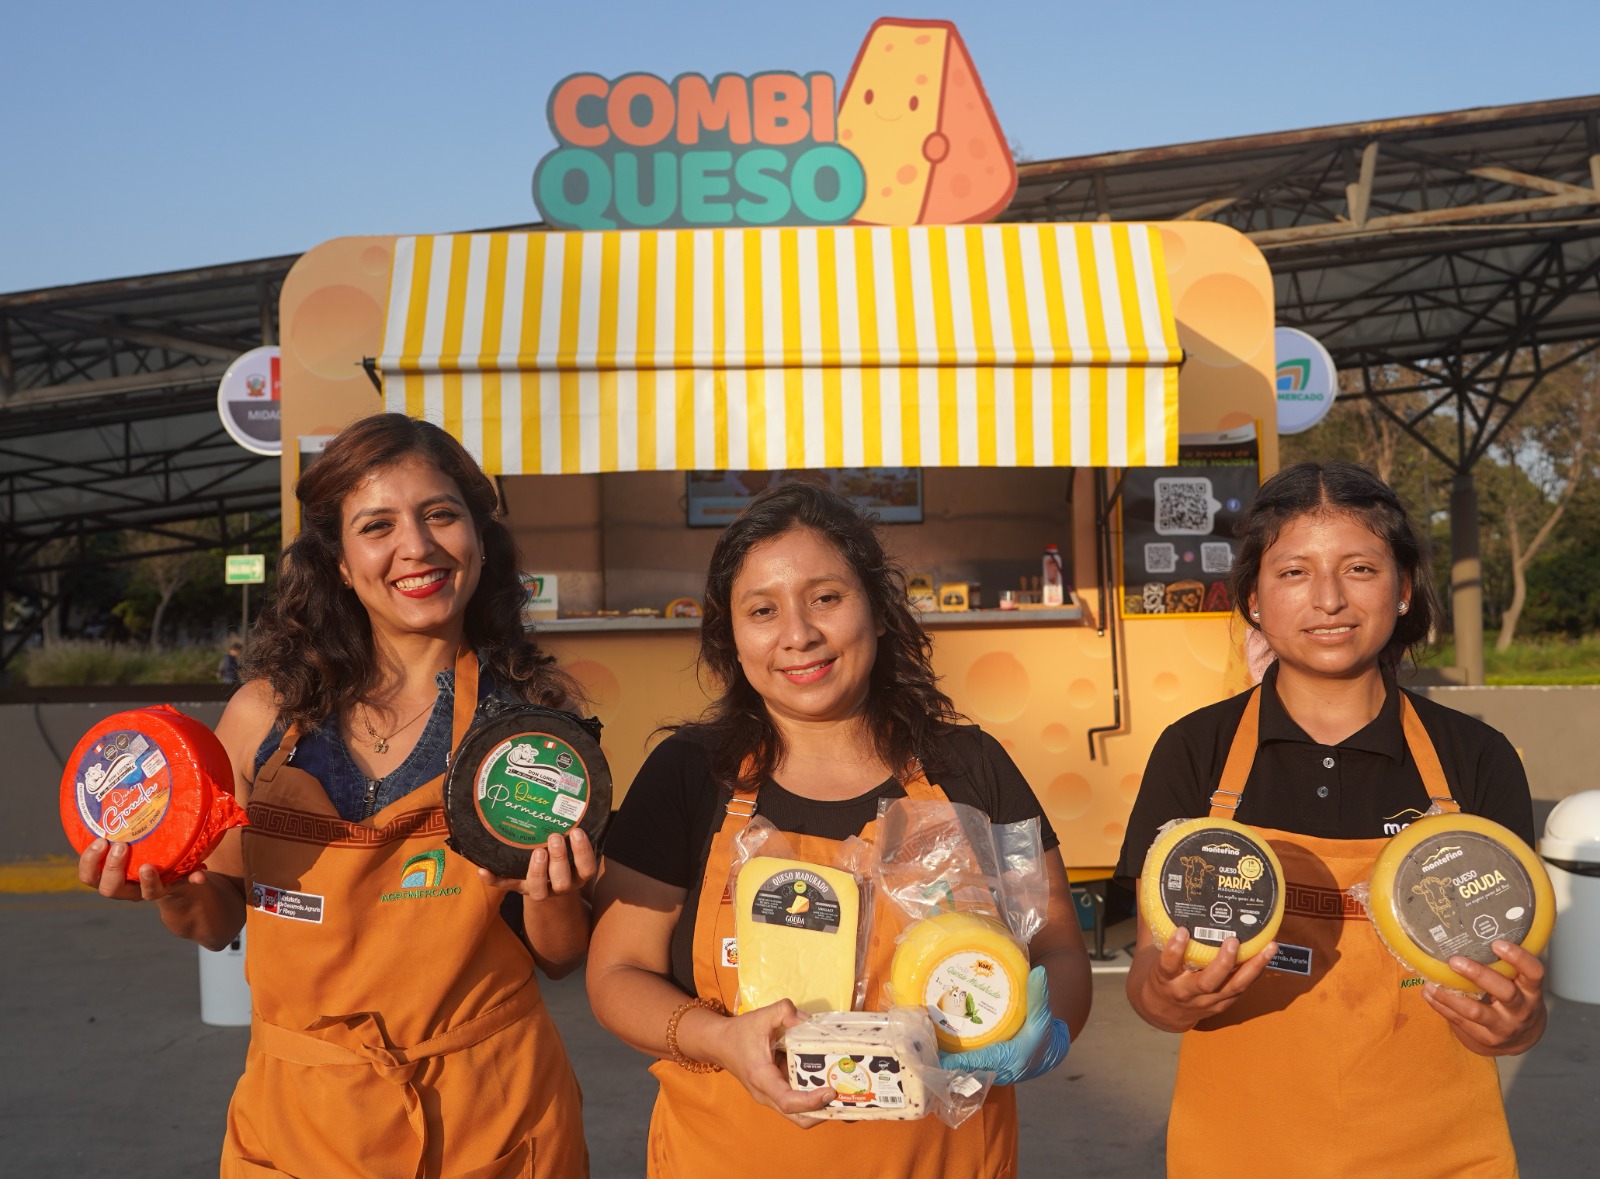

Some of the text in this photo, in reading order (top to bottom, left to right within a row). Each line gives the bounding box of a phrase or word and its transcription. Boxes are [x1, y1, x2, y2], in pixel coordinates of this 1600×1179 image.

[553, 74, 835, 147] COMBI
[539, 147, 865, 231] QUESO
[514, 781, 550, 805] Queso
[103, 783, 158, 835] Gouda
[487, 783, 571, 828] Parmesano
[1202, 845, 1240, 856] montefino
[1422, 849, 1463, 873] montefino
[772, 872, 829, 893] QUESO MADURADO
[1218, 866, 1237, 875] QUESO
[1452, 869, 1477, 887] QUESO
[380, 886, 461, 903] AGROMERCADO
[1458, 869, 1506, 899] GOUDA
